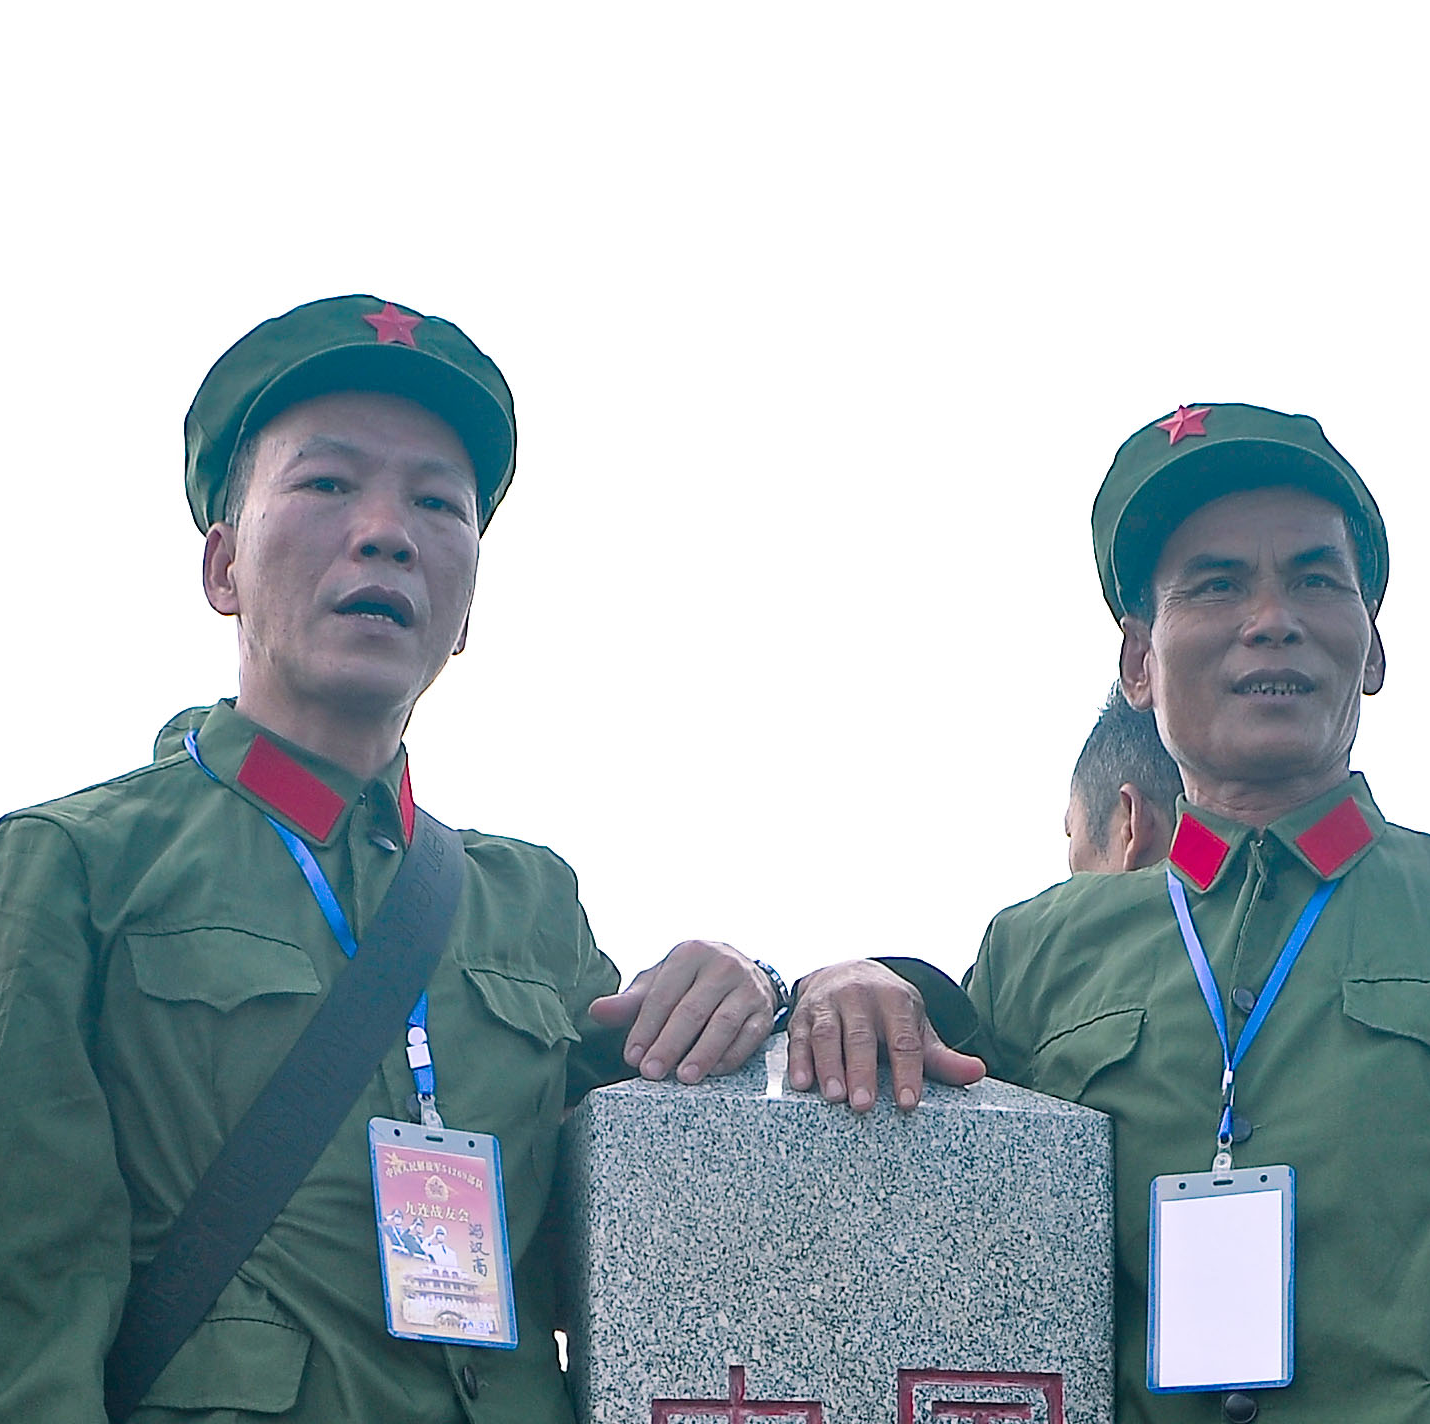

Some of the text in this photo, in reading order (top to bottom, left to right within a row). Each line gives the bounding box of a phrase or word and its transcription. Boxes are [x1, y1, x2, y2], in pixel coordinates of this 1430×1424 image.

[405, 1201, 470, 1223] 九连战友会
